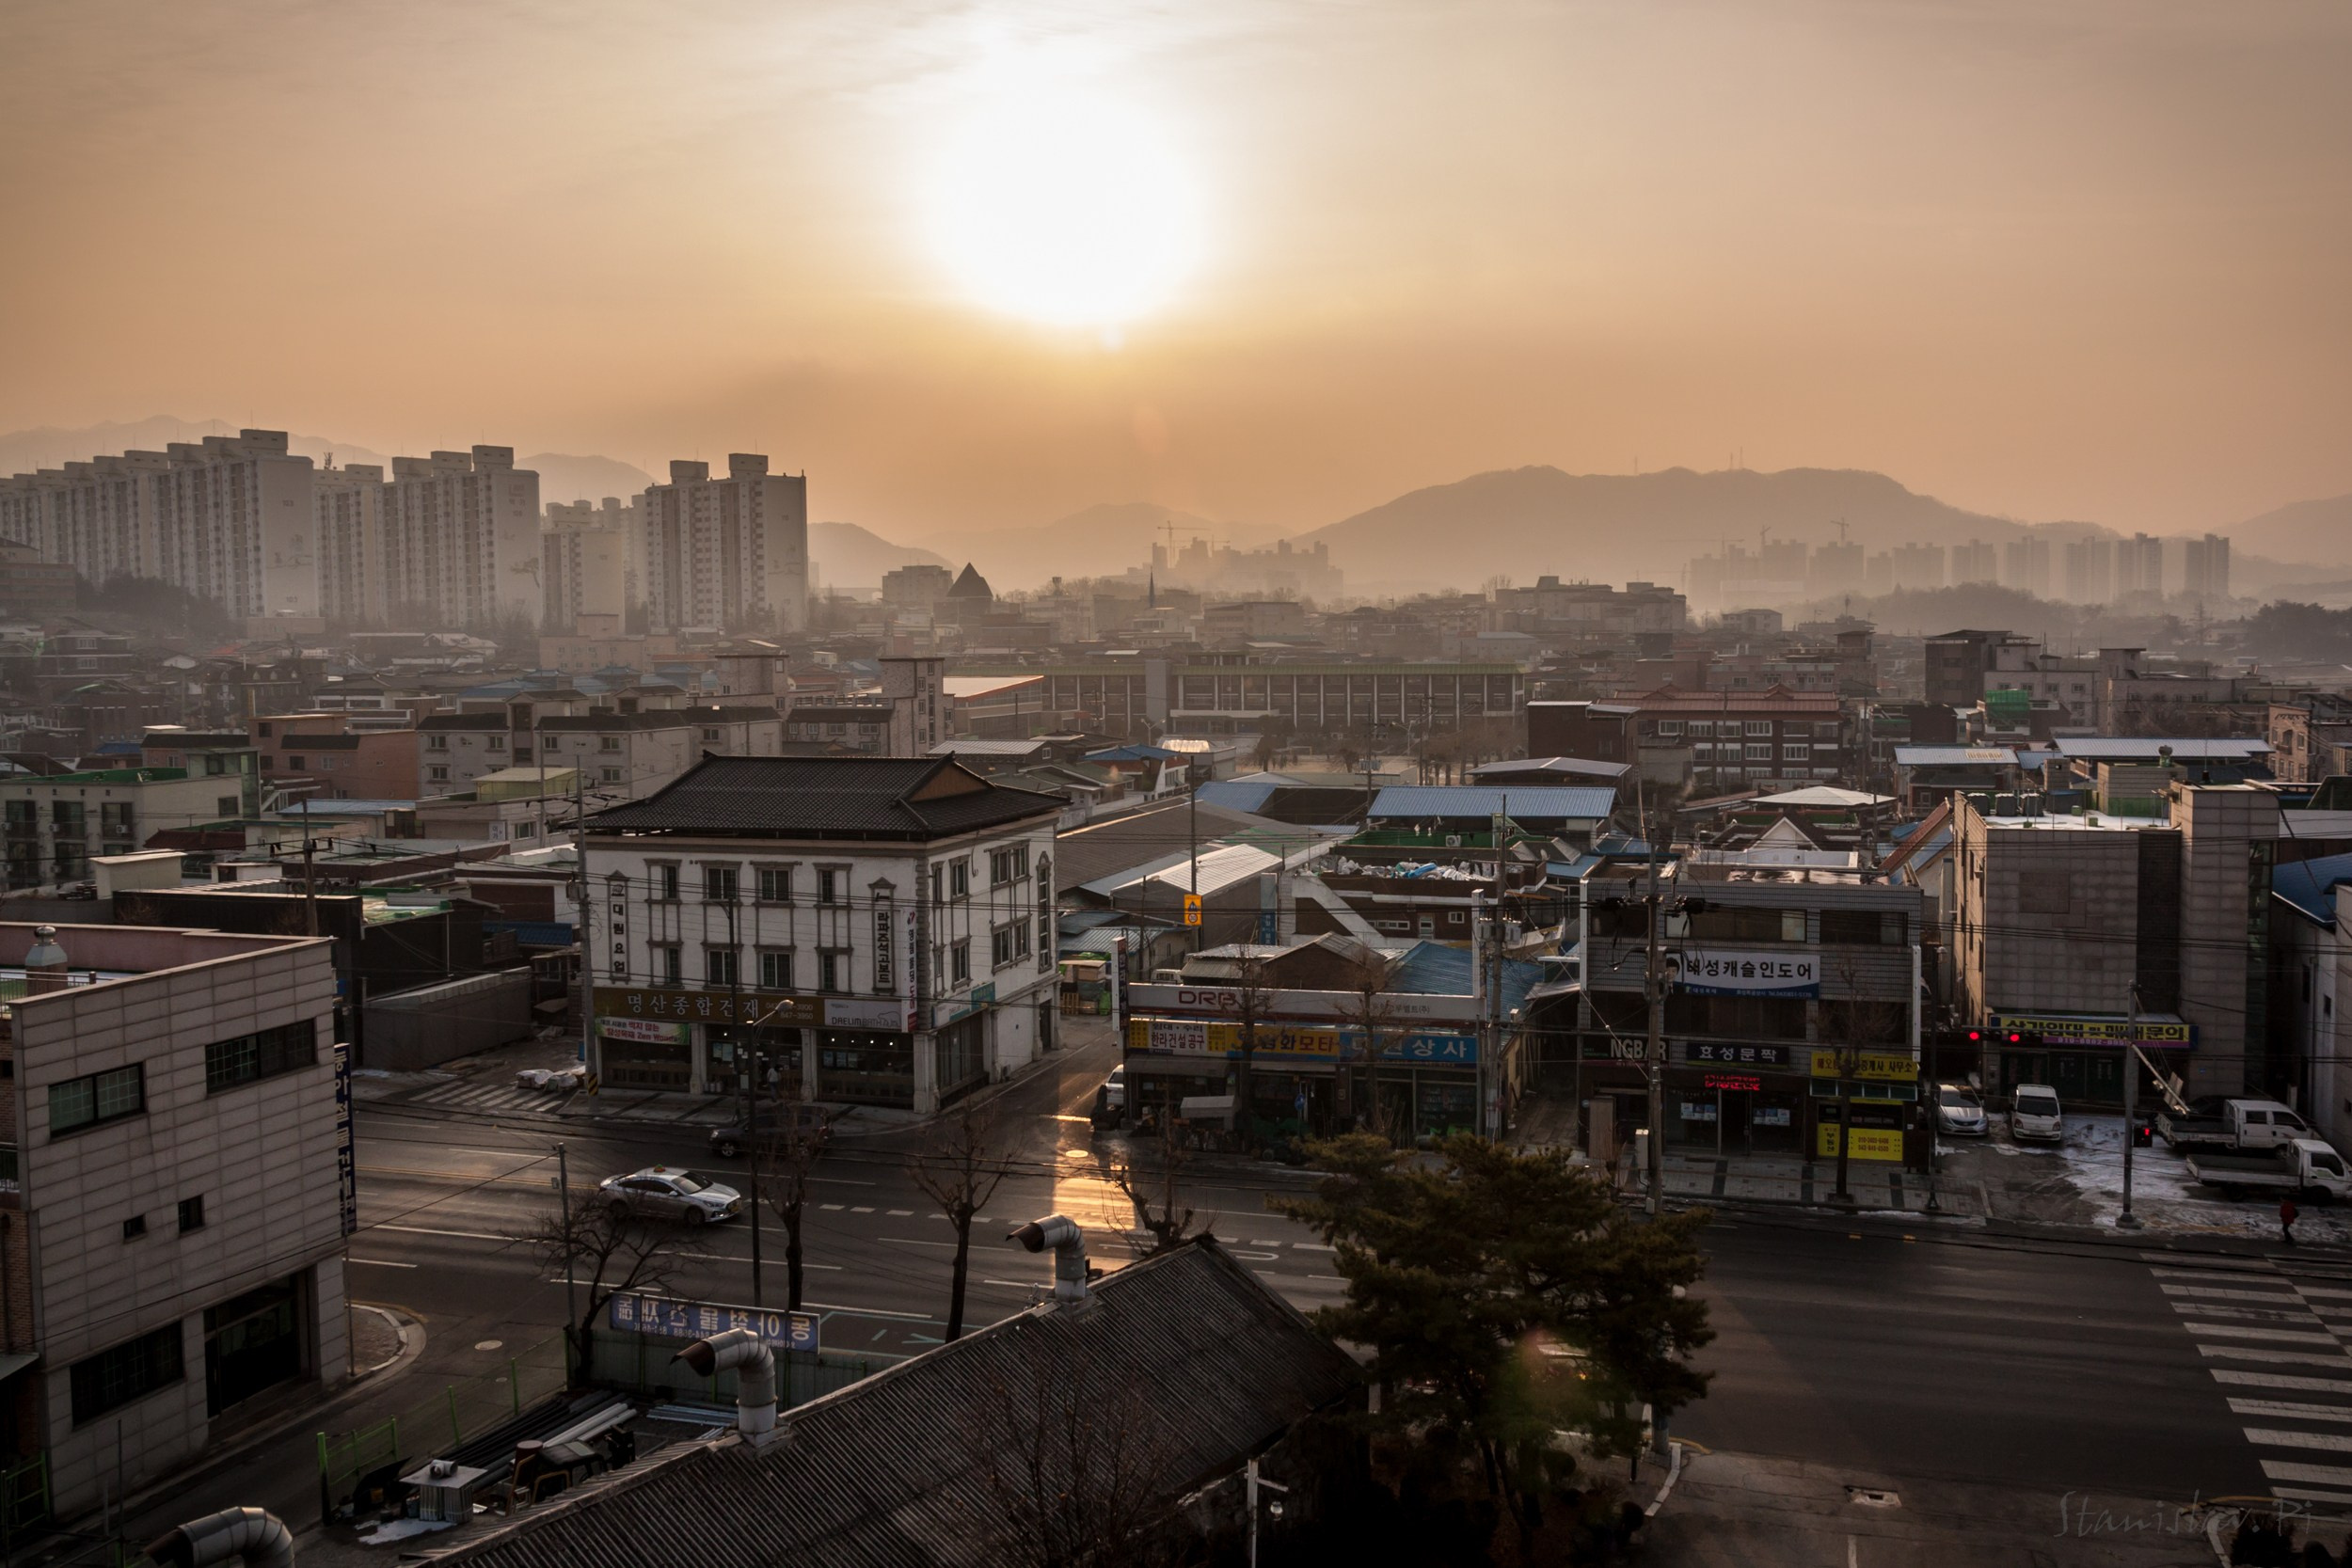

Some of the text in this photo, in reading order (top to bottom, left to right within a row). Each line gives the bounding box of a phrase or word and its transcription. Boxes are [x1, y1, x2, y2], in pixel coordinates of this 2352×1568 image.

[612, 904, 625, 973] 대림요업
[878, 911, 890, 984] 라파즈석고보드
[1179, 990, 1237, 1006] DRB
[1151, 1032, 1205, 1050] 한라건설공구
[1698, 1045, 1777, 1063] 효성문짝
